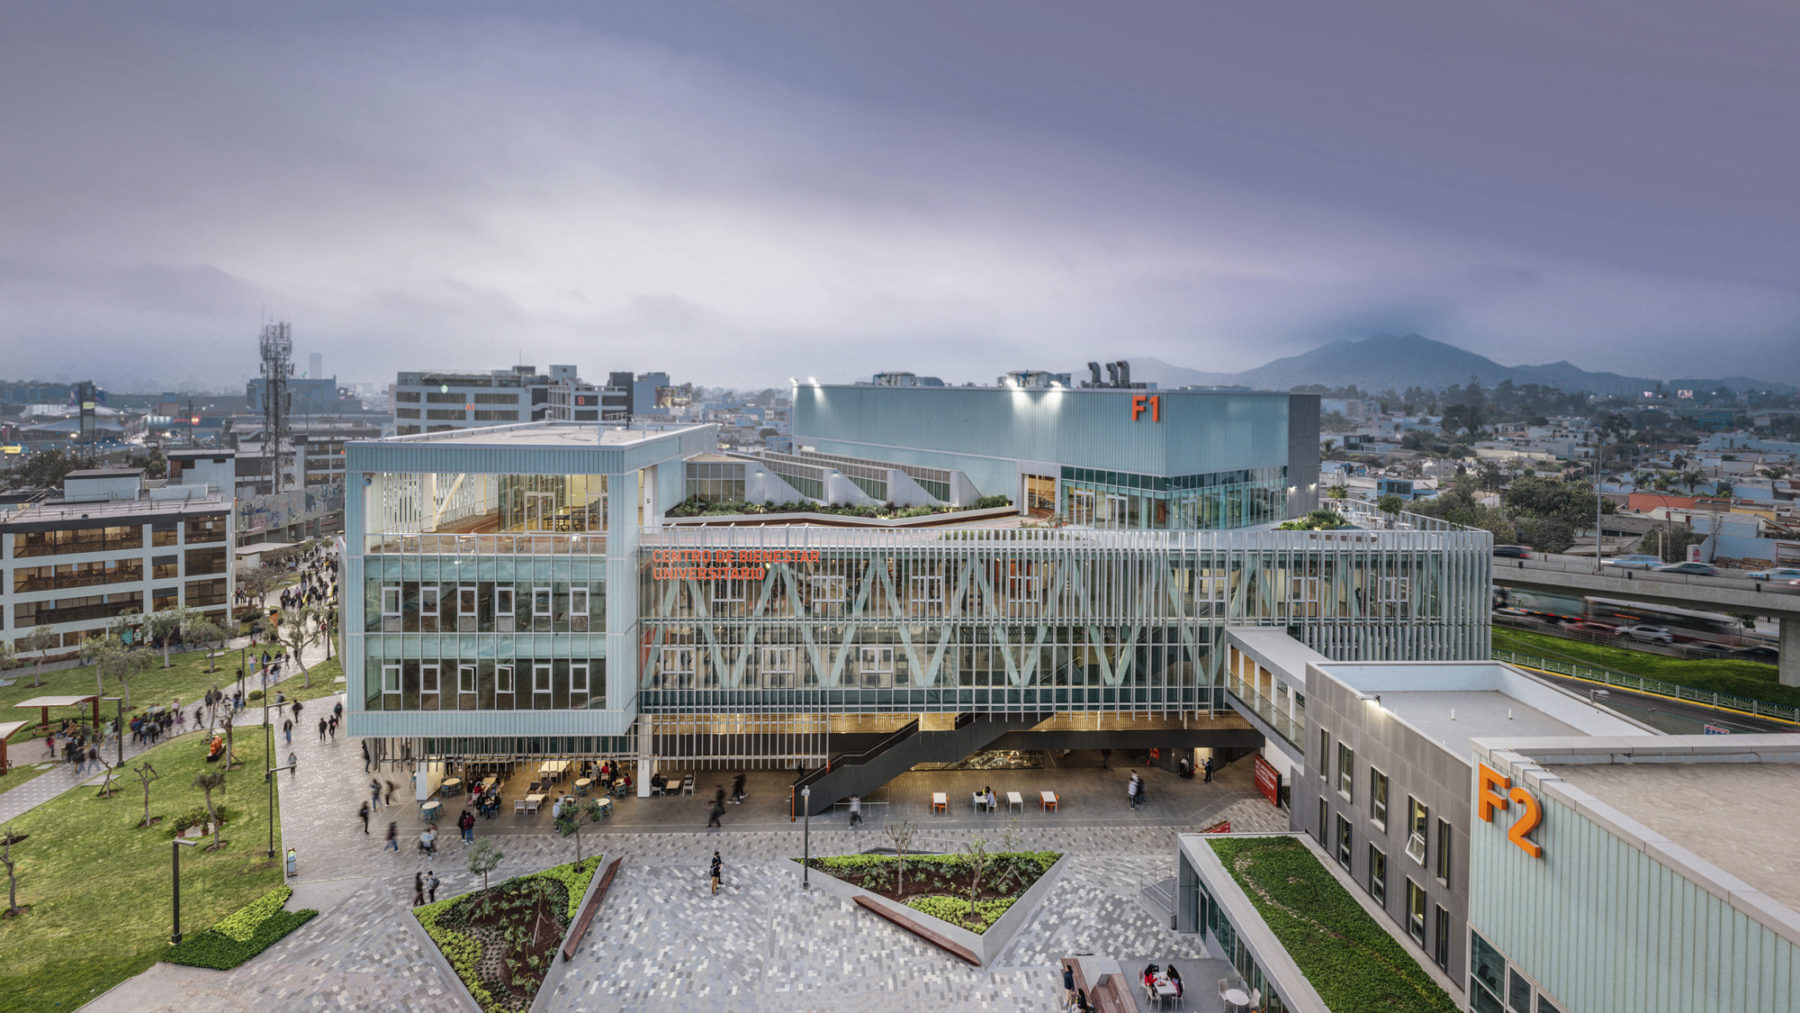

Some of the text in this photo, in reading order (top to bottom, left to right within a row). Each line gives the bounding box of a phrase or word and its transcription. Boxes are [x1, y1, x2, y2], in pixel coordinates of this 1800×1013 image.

[1132, 396, 1159, 422] F1
[652, 549, 820, 563] CENTRO DE BIENESTAR
[652, 567, 765, 580] UNIVERSITARIO
[1478, 762, 1542, 858] F2
